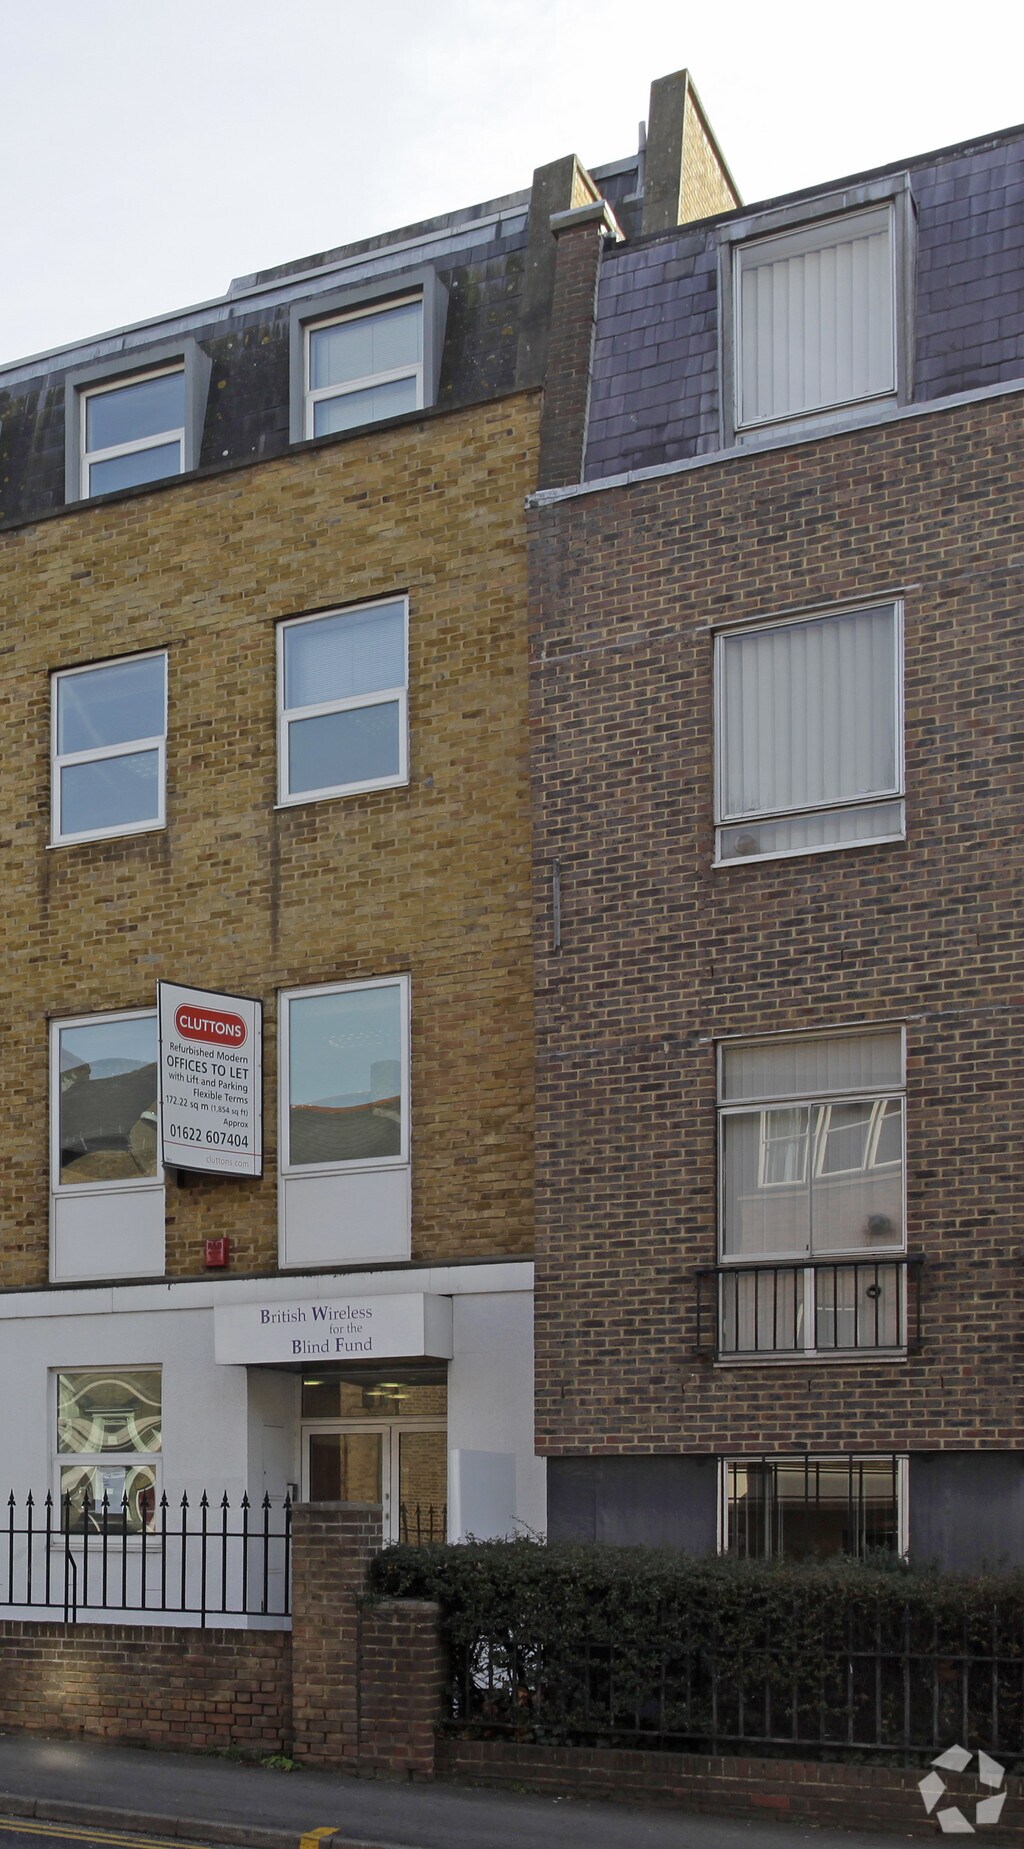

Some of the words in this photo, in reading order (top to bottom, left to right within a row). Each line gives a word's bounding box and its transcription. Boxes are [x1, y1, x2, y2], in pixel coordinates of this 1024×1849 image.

[179, 1015, 242, 1037] CLUTTONS
[169, 1042, 214, 1058] Refurbished
[217, 1051, 248, 1064] Modern
[167, 1055, 207, 1074] OFFICES
[211, 1063, 226, 1076] TO
[230, 1067, 249, 1079] LET
[169, 1071, 184, 1081] with
[187, 1074, 199, 1084] Lift
[201, 1079, 216, 1087] and
[219, 1080, 248, 1094] Parking
[166, 1094, 188, 1107] 172.22
[190, 1101, 199, 1111] sq
[231, 1108, 239, 1116] sq
[240, 1109, 249, 1117] ft)
[193, 1088, 222, 1100] Flexible
[224, 1093, 248, 1104] Terms
[223, 1118, 249, 1128] Approx
[170, 1124, 202, 1142] 01622
[206, 1130, 249, 1148] 607404
[206, 1155, 249, 1167] cluttons.com
[260, 1307, 306, 1324] British
[312, 1305, 373, 1321] Wireless
[329, 1324, 344, 1334] for
[347, 1322, 363, 1333] the
[292, 1339, 329, 1354] Blind
[335, 1337, 373, 1352] Fund
